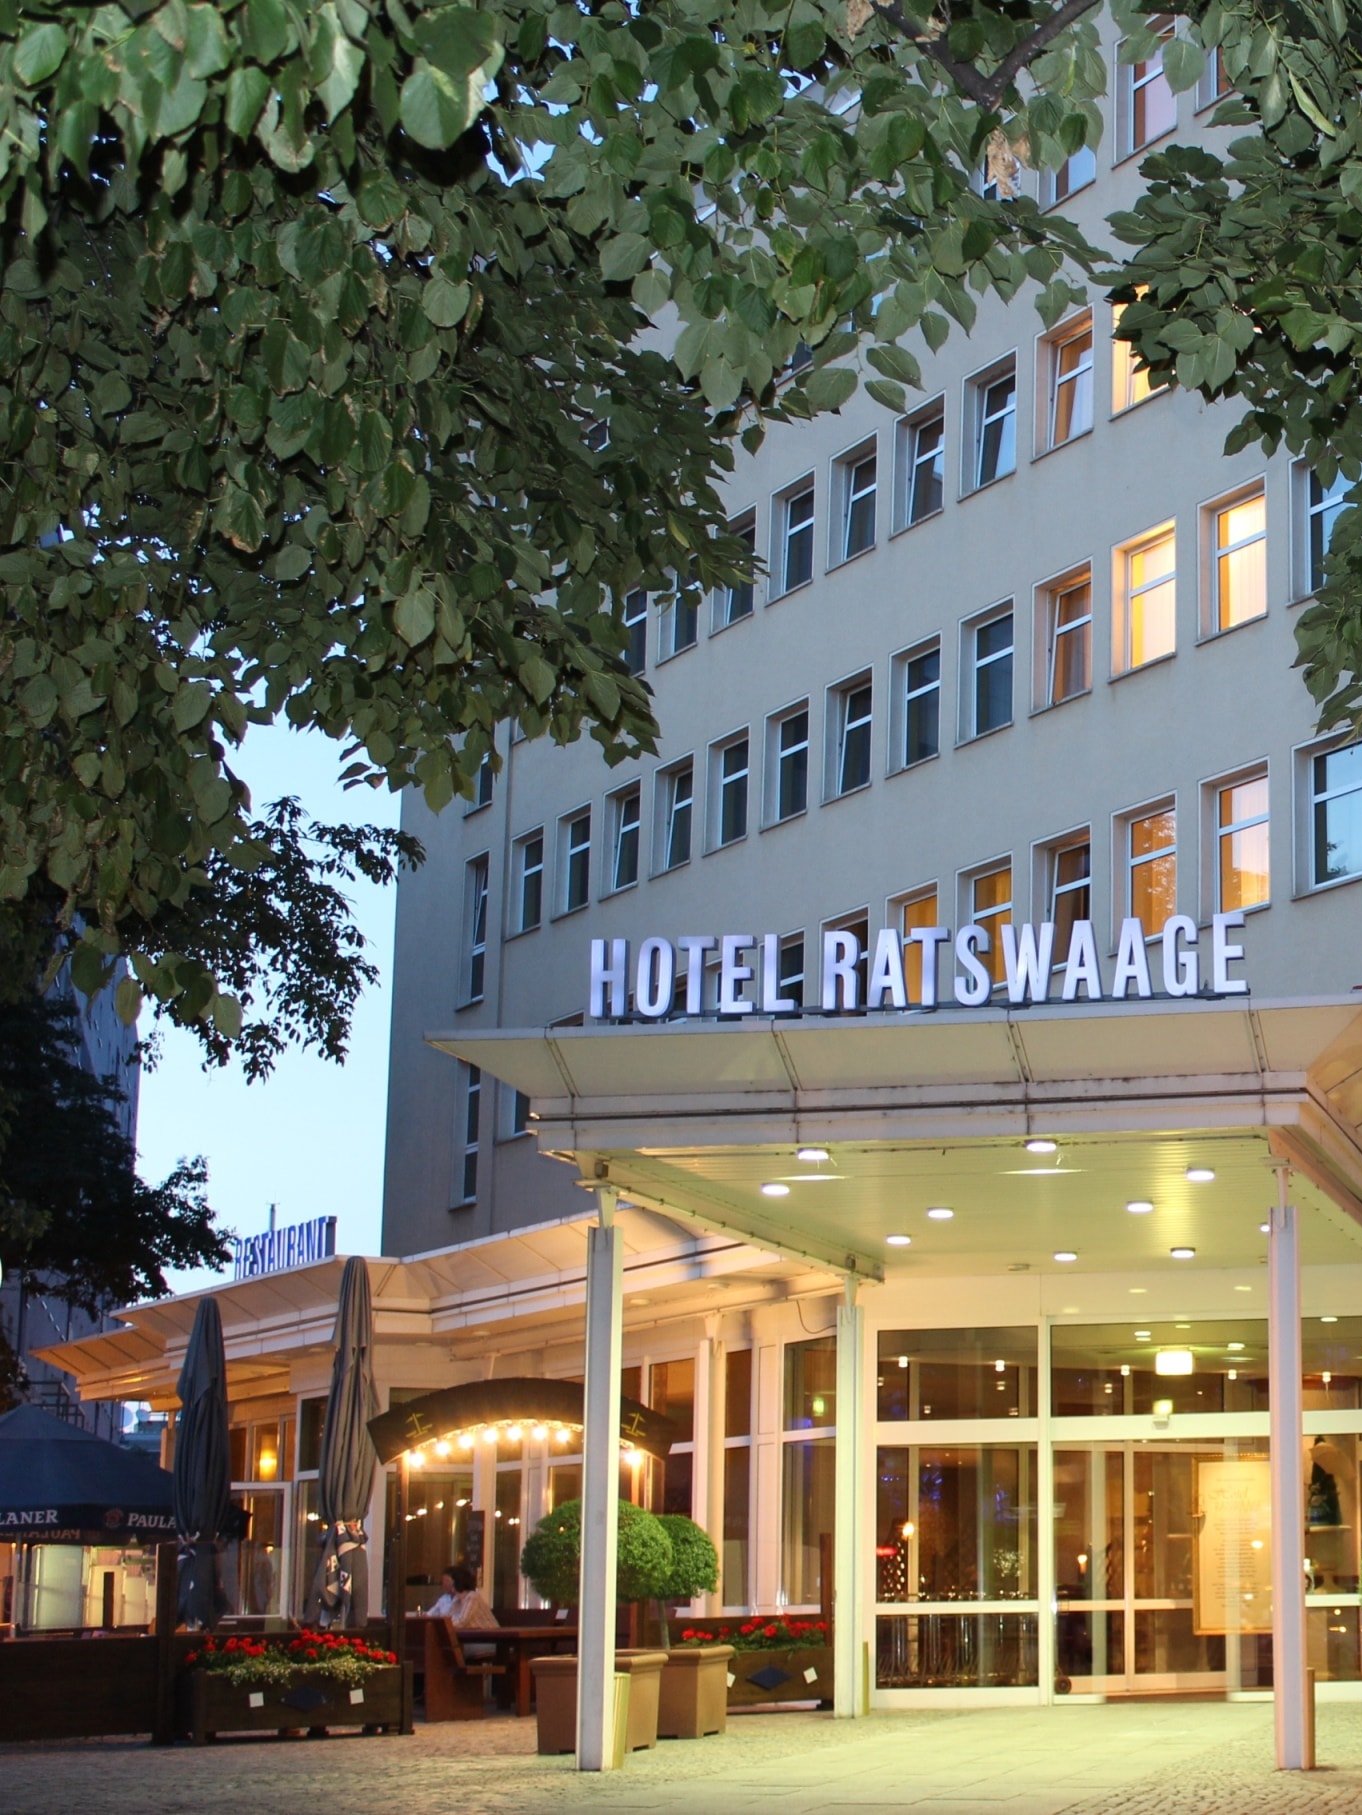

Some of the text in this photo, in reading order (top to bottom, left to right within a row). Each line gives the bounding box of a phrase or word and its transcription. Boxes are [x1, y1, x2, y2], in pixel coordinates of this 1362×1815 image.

[589, 912, 1251, 1020] HOTEL RATSWAAGE
[235, 1215, 333, 1281] RESTAURANT
